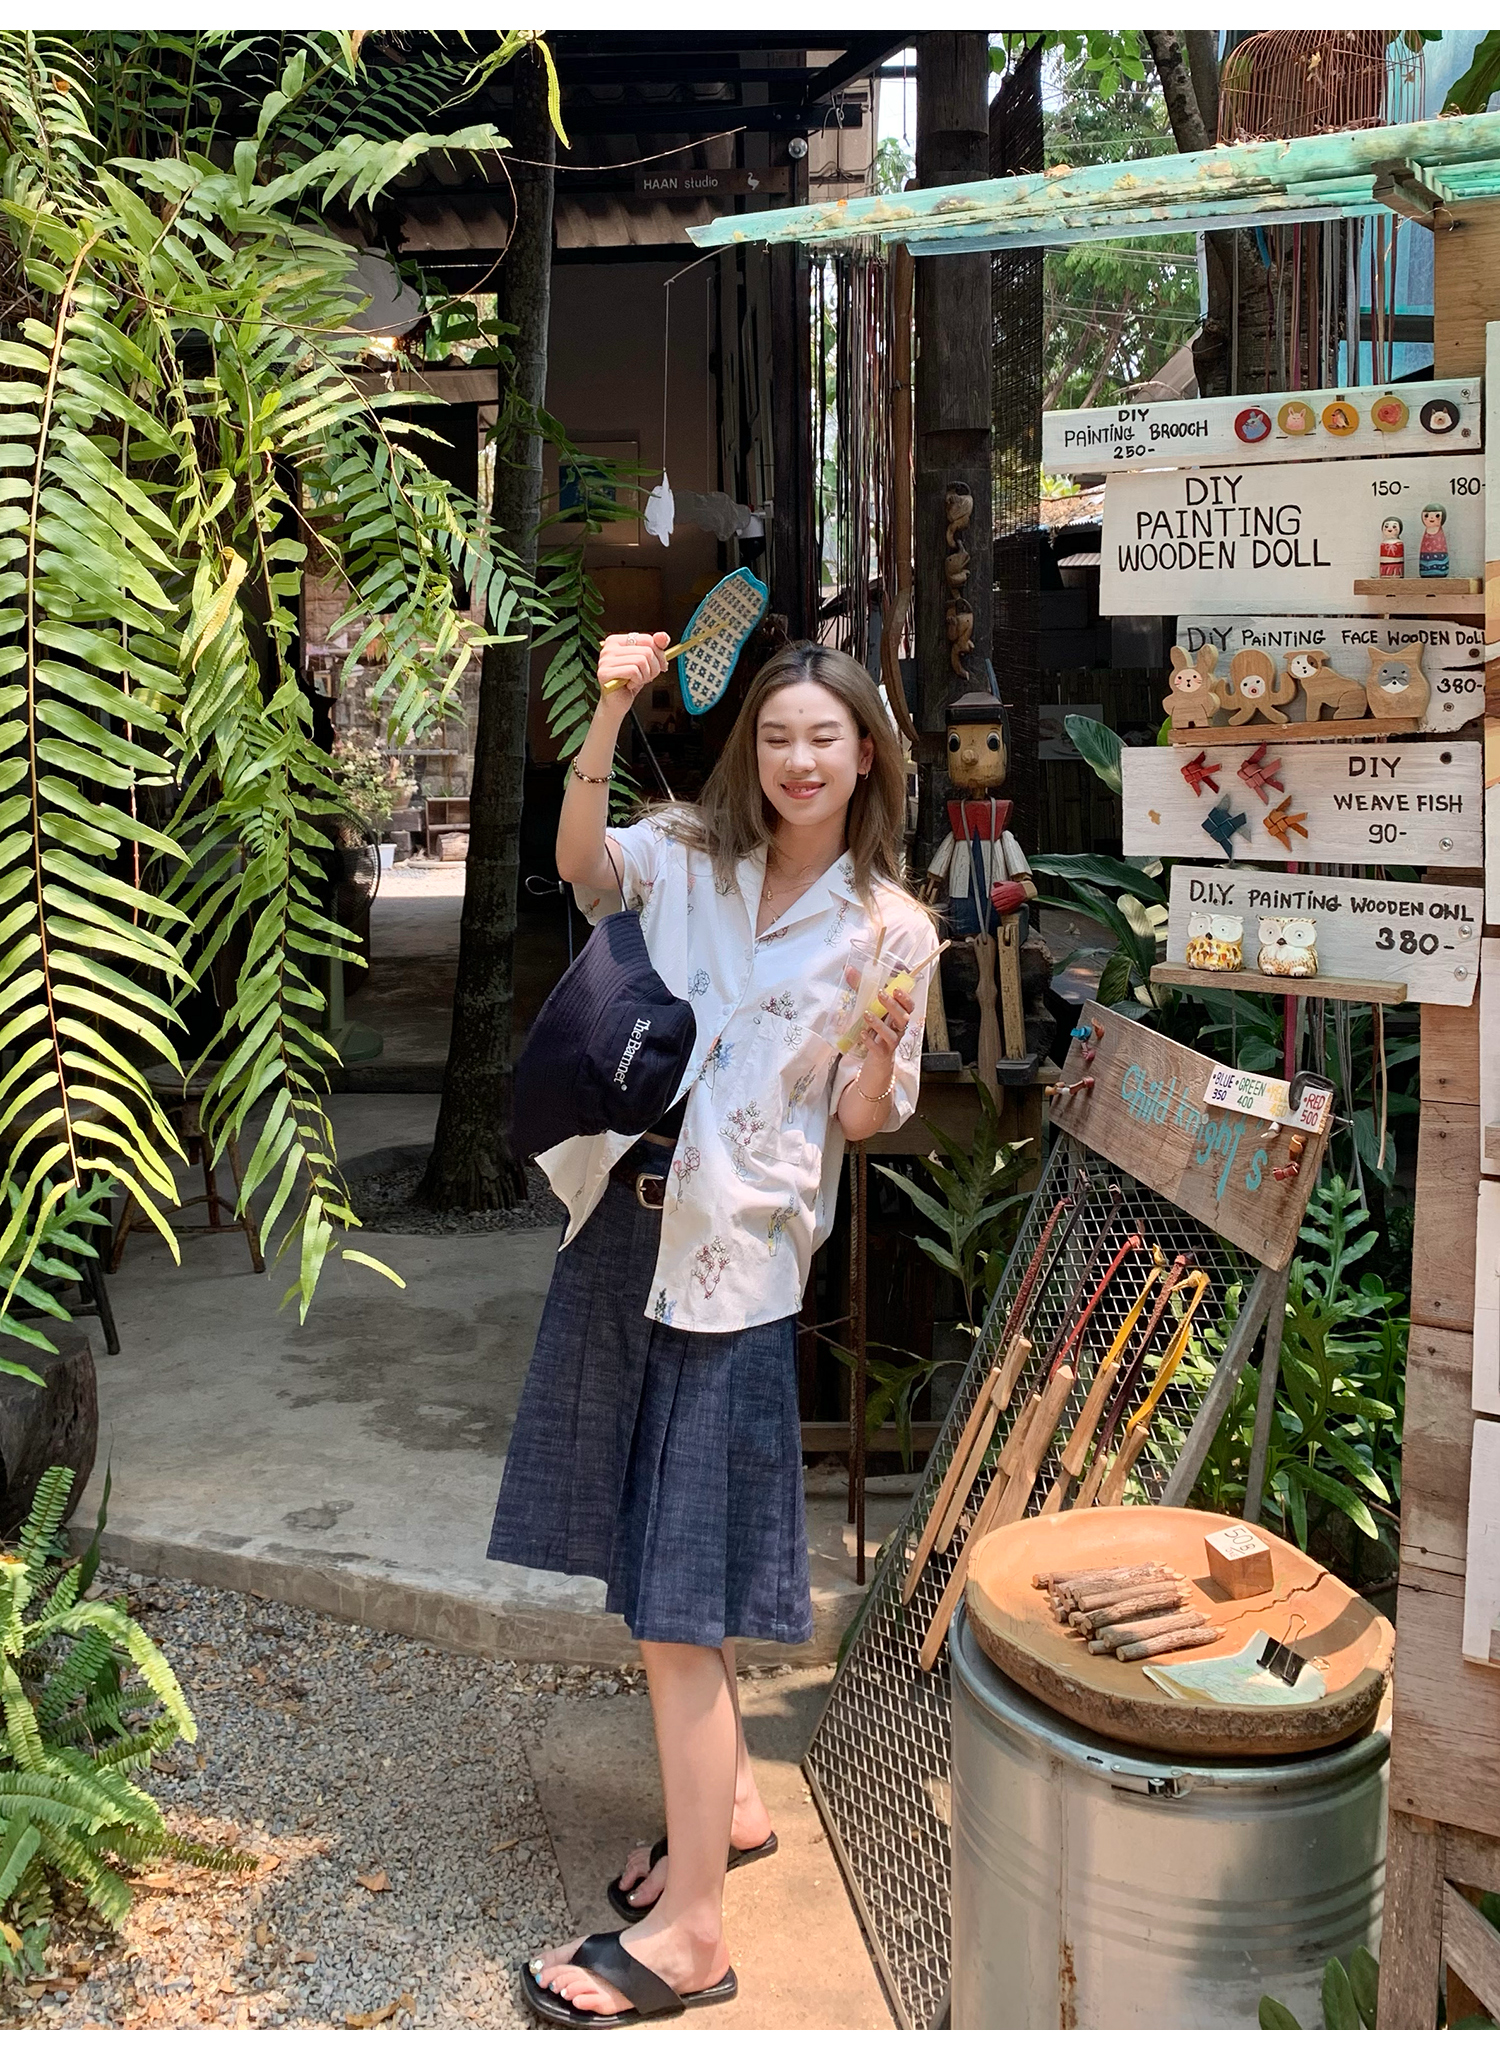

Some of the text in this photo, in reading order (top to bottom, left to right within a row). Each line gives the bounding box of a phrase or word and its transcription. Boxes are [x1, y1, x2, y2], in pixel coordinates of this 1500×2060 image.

[643, 175, 718, 190] HAAN studio
[1118, 408, 1149, 422] DIY
[1149, 420, 1208, 441] BROOCH
[1113, 445, 1155, 459] 250-
[1185, 475, 1243, 506] DIY
[1371, 480, 1410, 496] 150-
[1137, 504, 1302, 540] PAINTING
[1118, 538, 1331, 572] WOODEN DOLL
[1341, 629, 1378, 645] FACE
[1348, 756, 1401, 778] DIY
[1333, 793, 1463, 813] WEAVE FISH
[1368, 823, 1407, 844] 90-
[1190, 879, 1235, 906] D.I.Y.
[1350, 897, 1424, 917] WOODEN
[1429, 903, 1474, 922] OWL
[1375, 927, 1455, 955] 380-
[631, 1018, 651, 1040] The
[1121, 1063, 1177, 1125] Child
[1214, 1071, 1236, 1089] BLUE
[1238, 1077, 1267, 1097] GREEN
[1305, 1093, 1326, 1110] RED
[1212, 1089, 1228, 1101] 350
[1236, 1095, 1254, 1109] 400
[1300, 1109, 1318, 1126] 500
